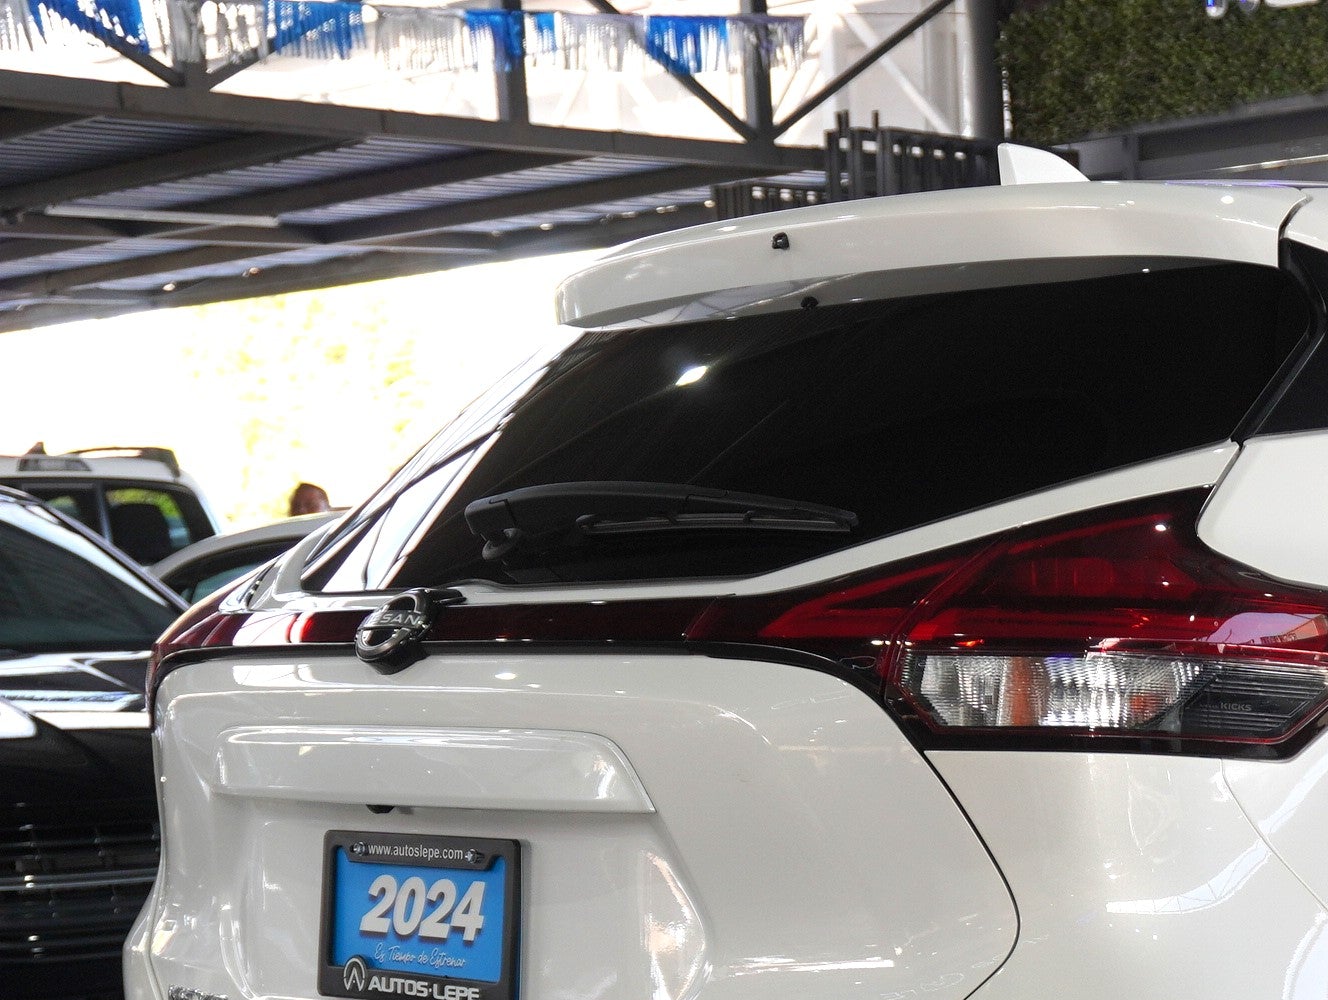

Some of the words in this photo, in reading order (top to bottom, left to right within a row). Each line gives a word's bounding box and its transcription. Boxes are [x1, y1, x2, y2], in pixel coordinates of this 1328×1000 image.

[1220, 702, 1252, 712] KICKS
[368, 843, 463, 861] www.autoslepe.com
[359, 874, 486, 942] 2024
